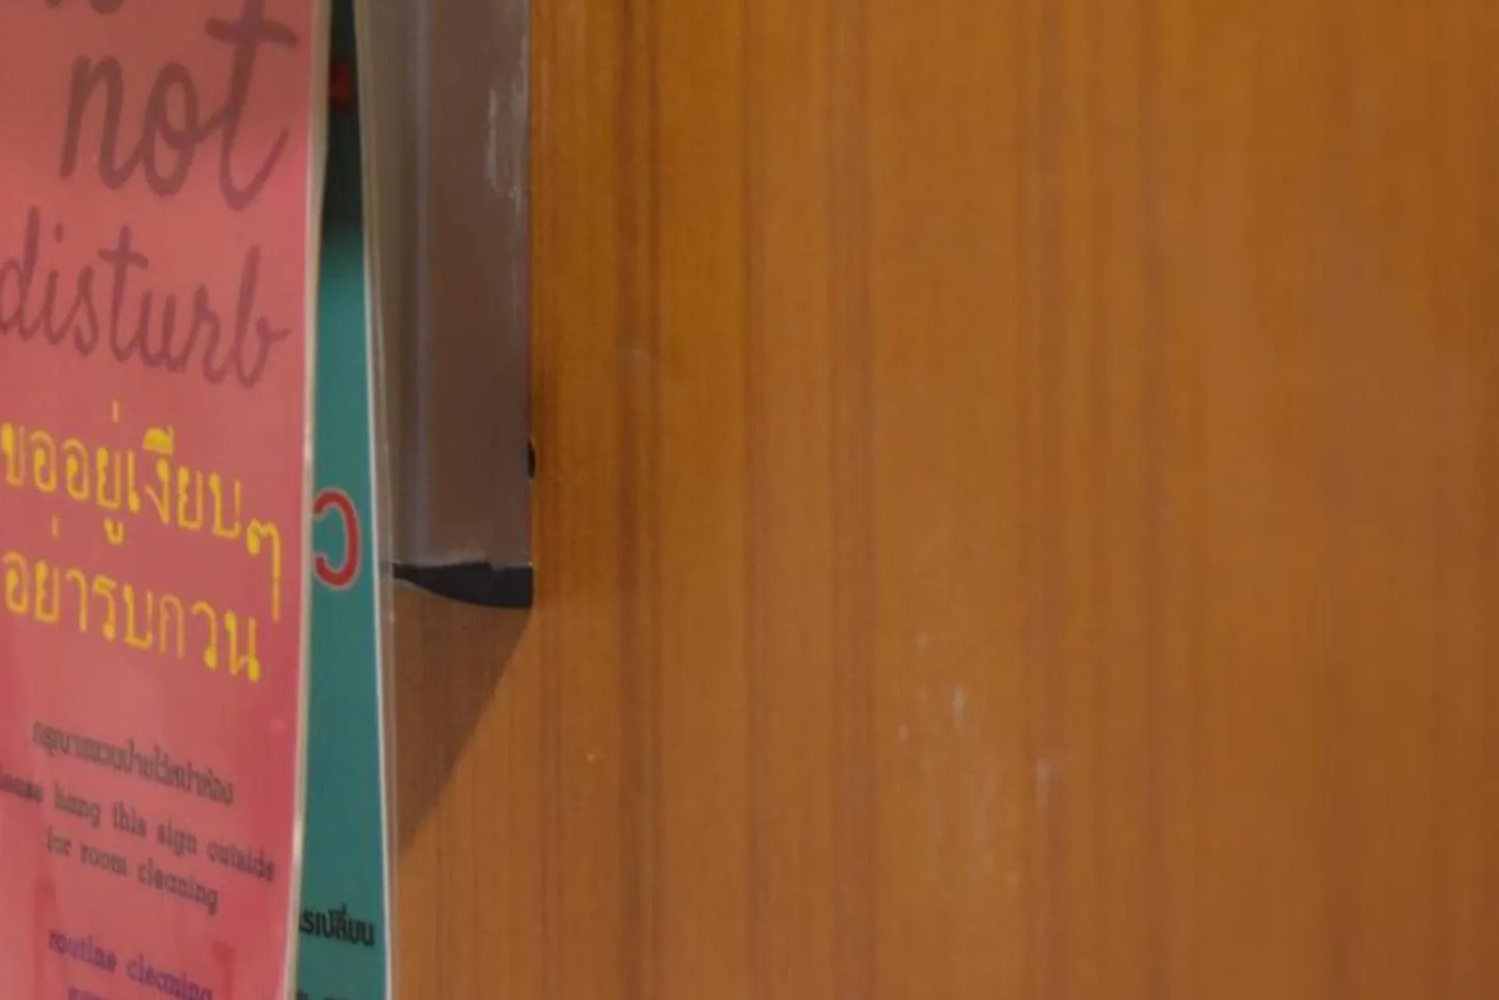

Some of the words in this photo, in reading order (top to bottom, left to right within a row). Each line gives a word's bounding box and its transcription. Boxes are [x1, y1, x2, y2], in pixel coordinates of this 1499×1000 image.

[1, 514, 261, 683] อย่ารบกวน
[45, 826, 72, 854] for
[80, 843, 129, 877] room
[137, 857, 220, 917] cleaning
[53, 780, 102, 829] hang
[113, 802, 147, 840] this
[157, 821, 198, 856] sign
[206, 834, 276, 882] outside
[49, 929, 117, 973] routine
